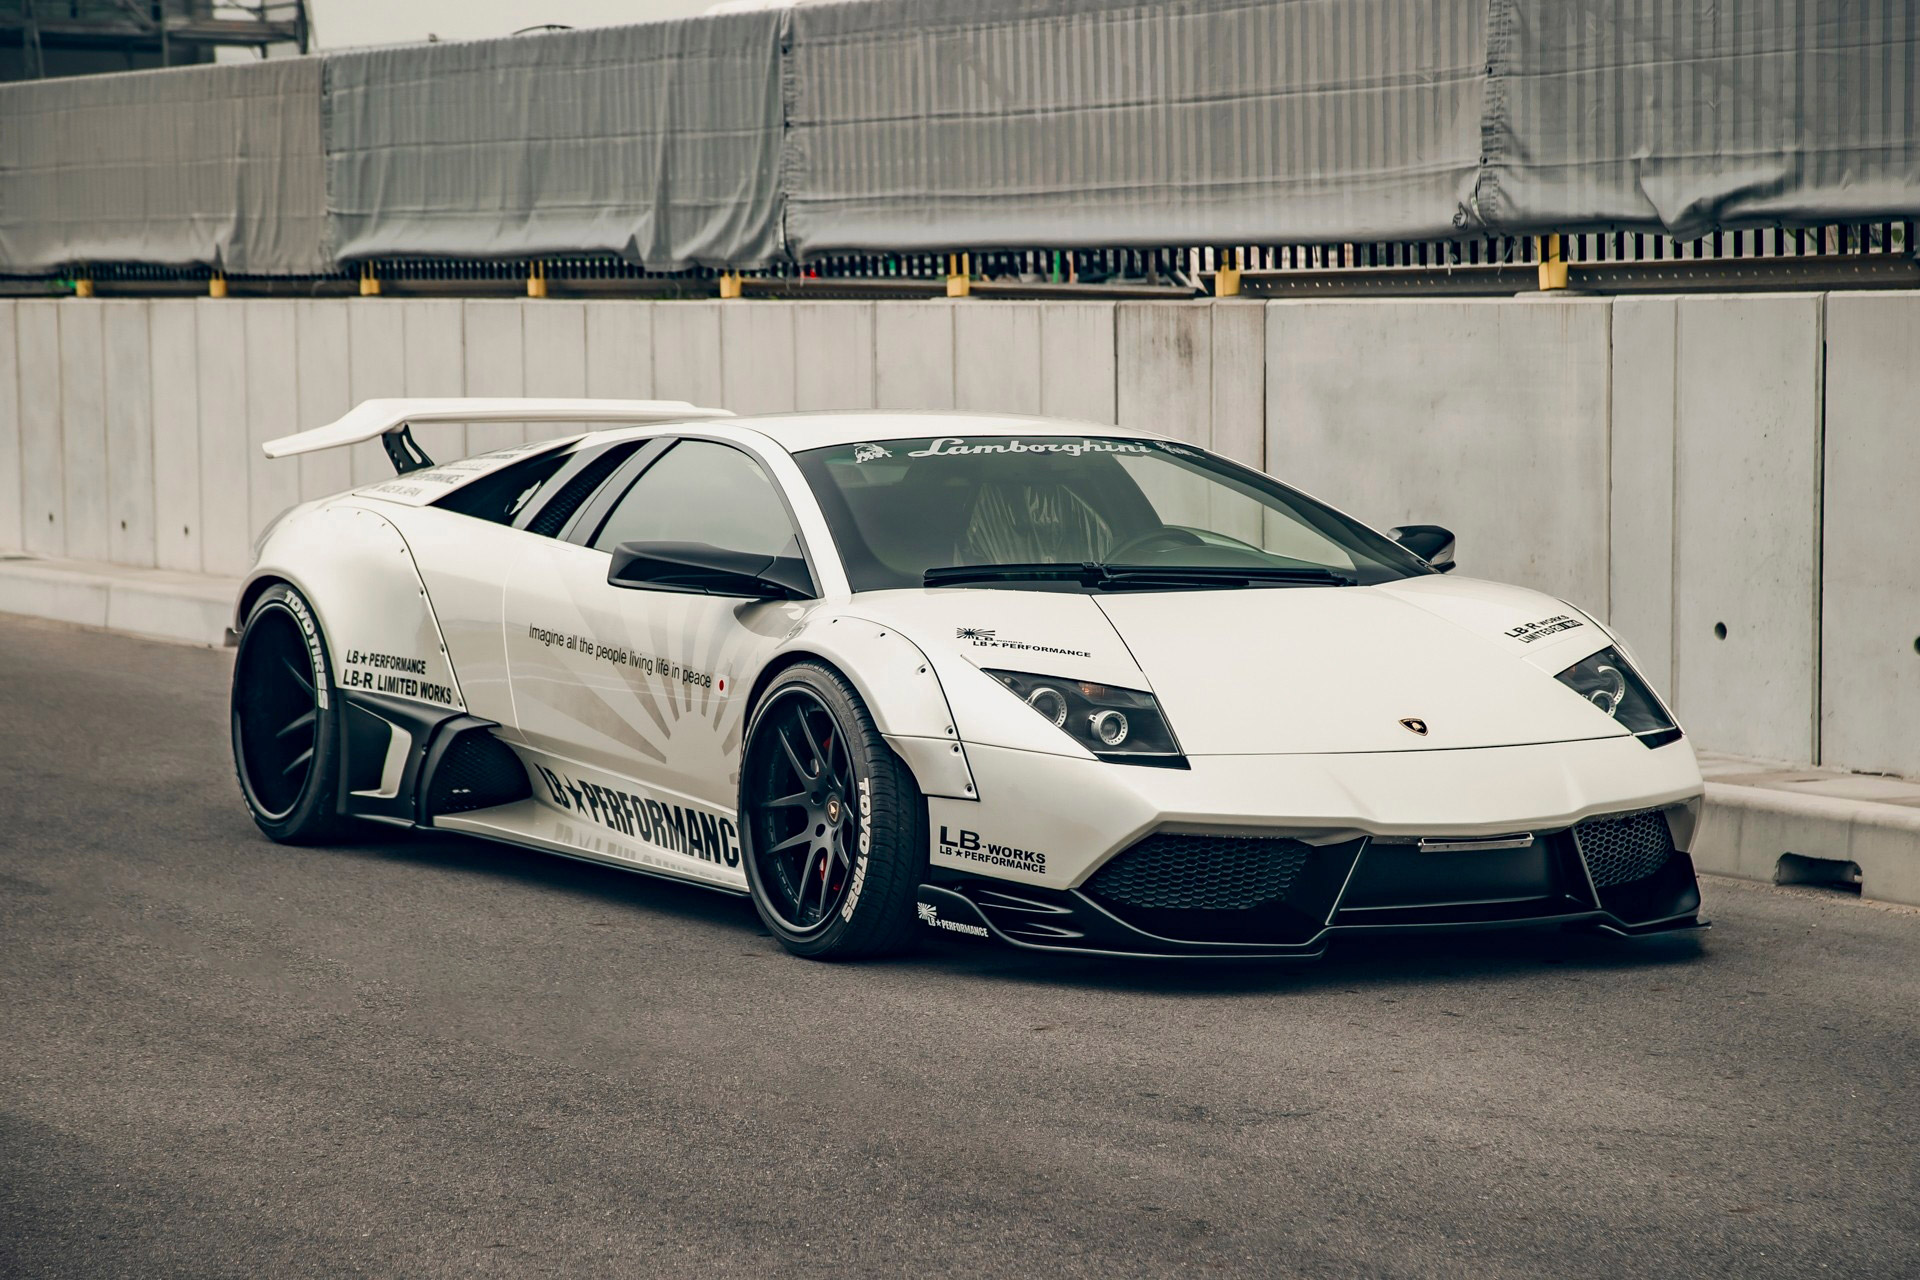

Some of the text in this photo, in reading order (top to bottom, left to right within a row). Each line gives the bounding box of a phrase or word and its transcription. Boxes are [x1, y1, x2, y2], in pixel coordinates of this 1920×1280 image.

[907, 437, 1152, 458] Lamborghini
[283, 590, 329, 710] TOYO TIRES
[369, 653, 426, 675] PERFORMANCE
[528, 622, 712, 689] Imagine all the people living life in peace
[1002, 642, 1091, 658] PERFORMANCE
[342, 669, 452, 705] LB-R LIMITED WORKS
[577, 779, 741, 868] PERFORMANC
[841, 777, 872, 923] TOYO TIRES
[964, 850, 1046, 874] PERFORMANCE
[941, 919, 989, 938] PERFORMANCE
